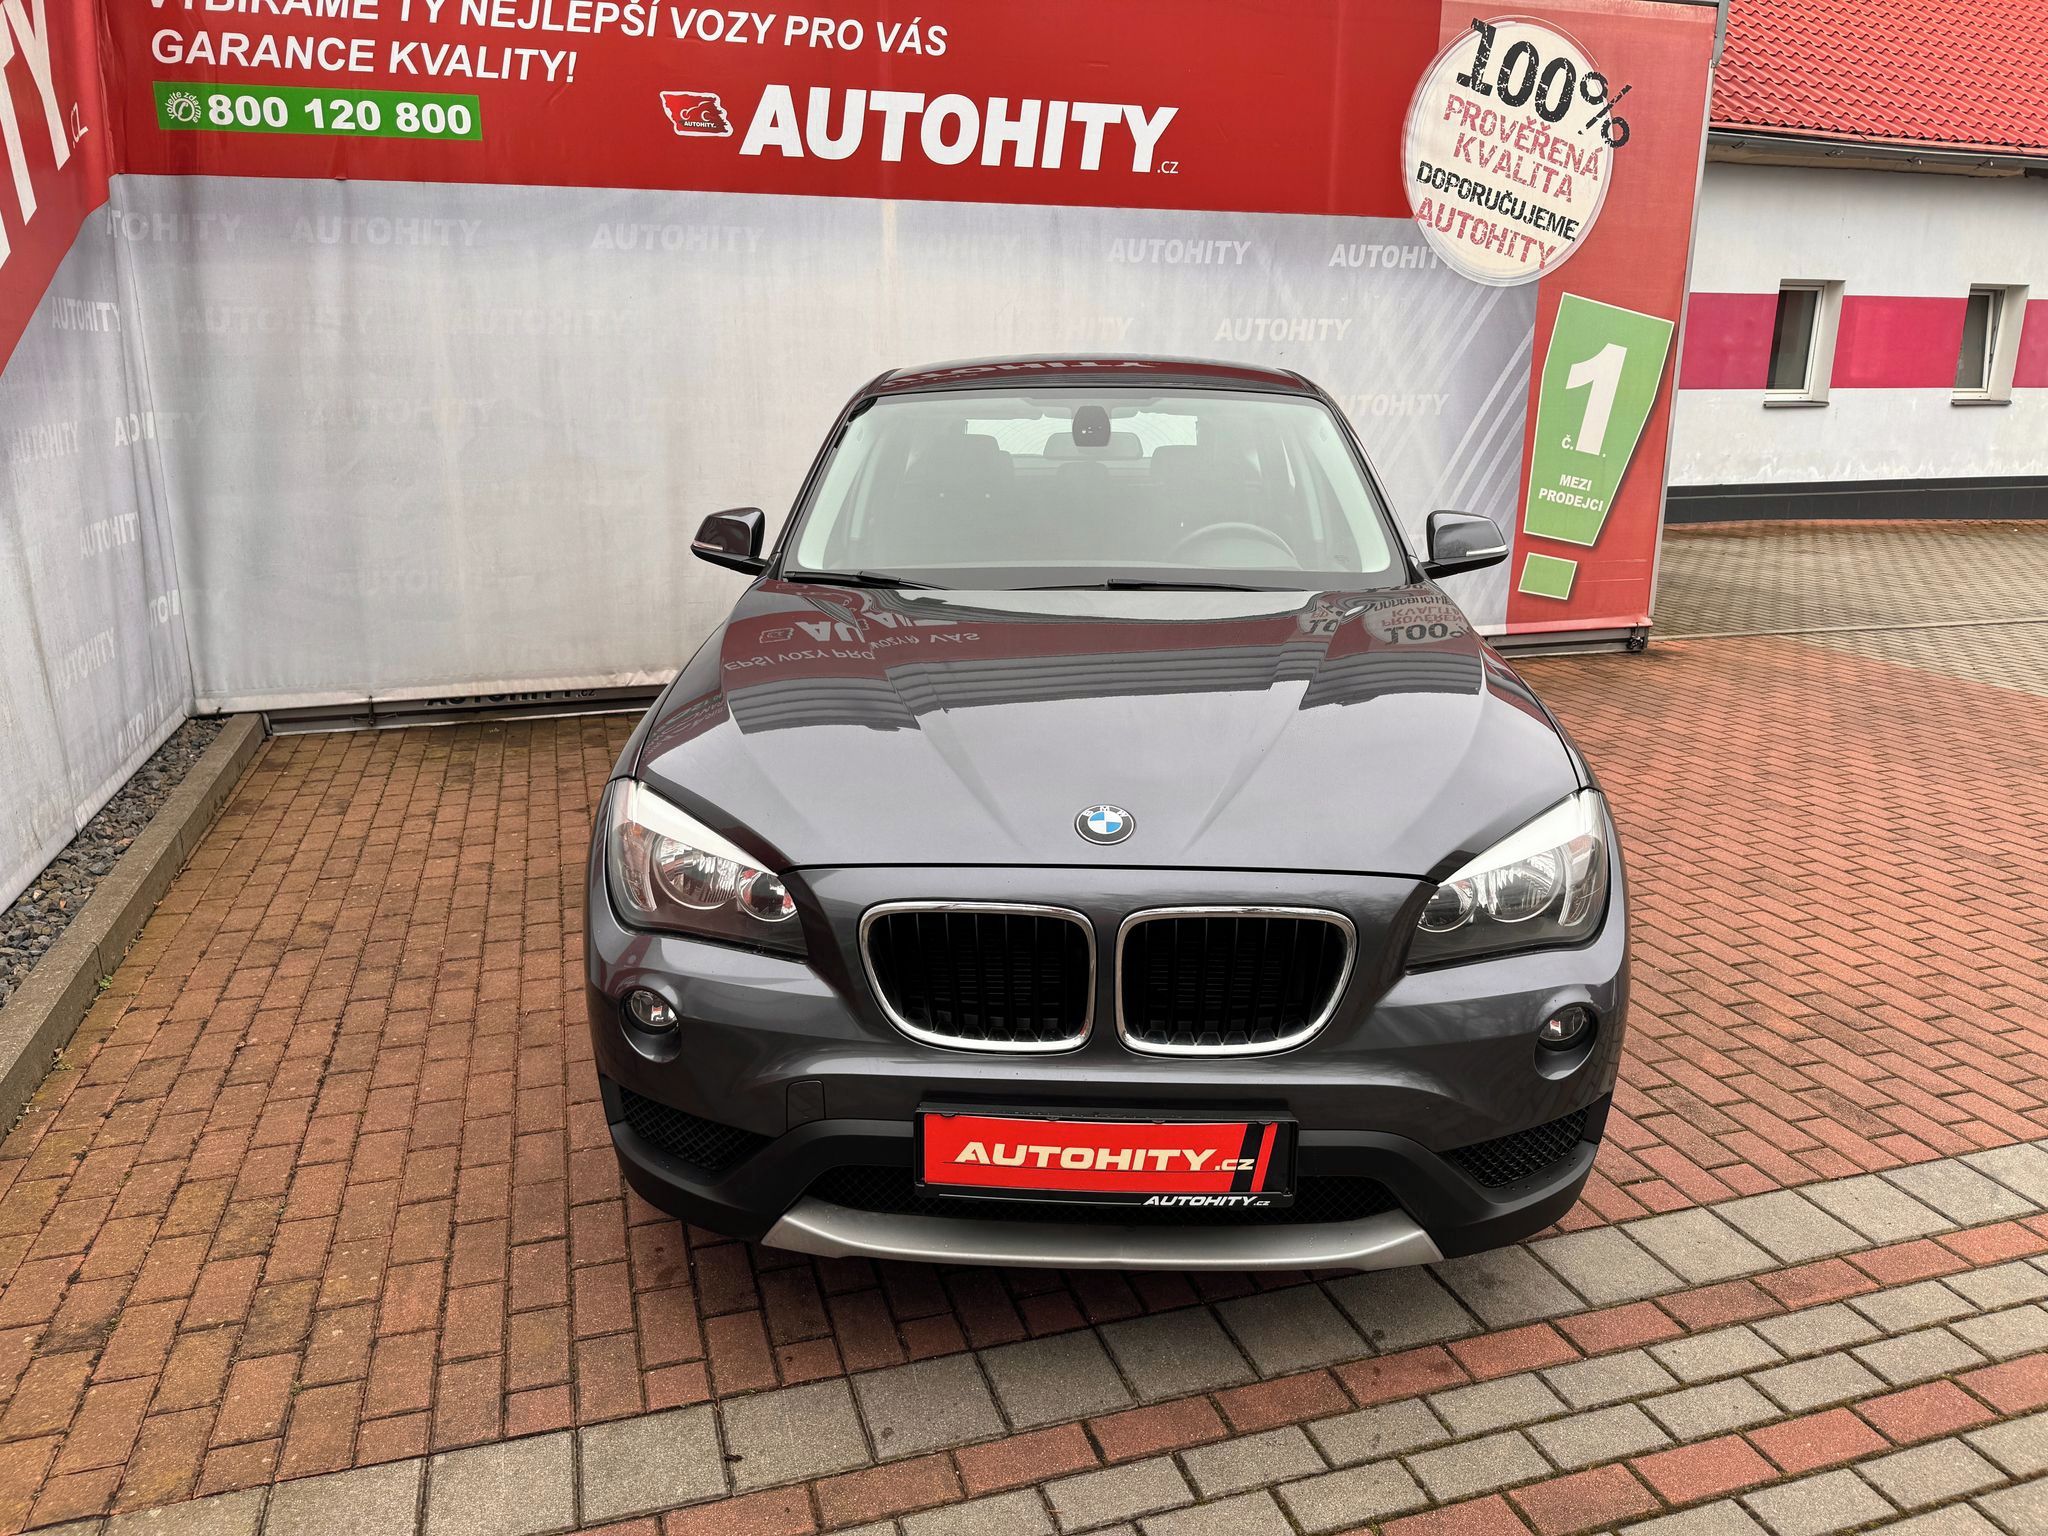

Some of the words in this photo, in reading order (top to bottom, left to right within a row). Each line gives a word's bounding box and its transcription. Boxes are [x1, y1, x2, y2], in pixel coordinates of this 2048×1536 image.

[459, 0, 656, 38] NEJLEPŠÍ
[670, 7, 777, 45] VOZY
[784, 15, 864, 51] PRO
[876, 17, 949, 57] VÁS
[151, 28, 376, 73] GARANCE
[388, 41, 577, 84] KVALITY!
[1457, 18, 1632, 149] 100%
[207, 94, 288, 128] 800
[304, 98, 381, 131] 120
[396, 102, 472, 135] 800
[1443, 94, 1603, 182] PROVĚŘENÁ
[1453, 132, 1573, 203] KVALITA
[1415, 160, 1579, 242] DOPORUČUJEME
[291, 216, 481, 246] AUTOHITY
[590, 221, 765, 252] AUTOHITY
[1107, 237, 1251, 266] AUTOHITY
[1413, 197, 1557, 270] AUTOHITY
[1214, 316, 1352, 342] AUTOHITY
[1538, 487, 1604, 512] PRODEJCI
[1560, 473, 1592, 492] MEZI
